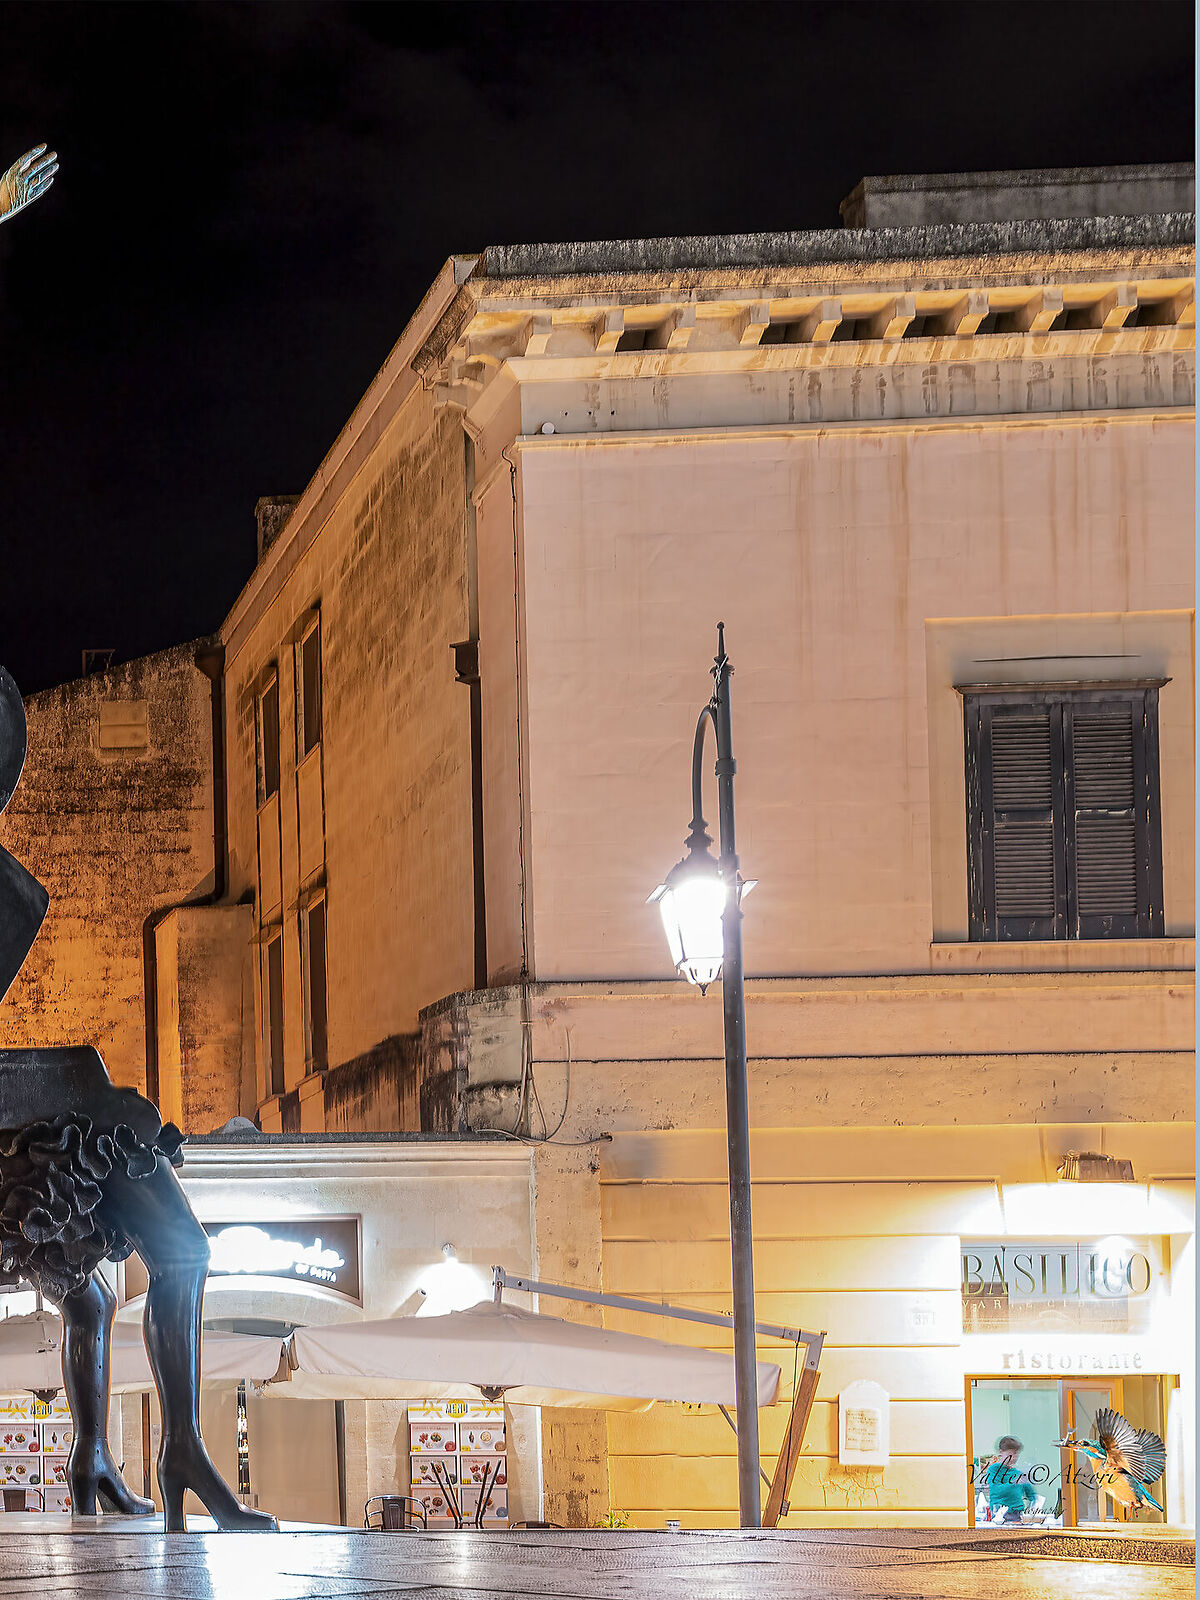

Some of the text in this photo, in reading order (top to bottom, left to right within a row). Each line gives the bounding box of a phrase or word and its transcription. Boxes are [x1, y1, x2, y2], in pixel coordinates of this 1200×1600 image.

[961, 1254, 1151, 1295] BASILICO
[1002, 1350, 1143, 1370] ristorante
[445, 1403, 468, 1414] MENU
